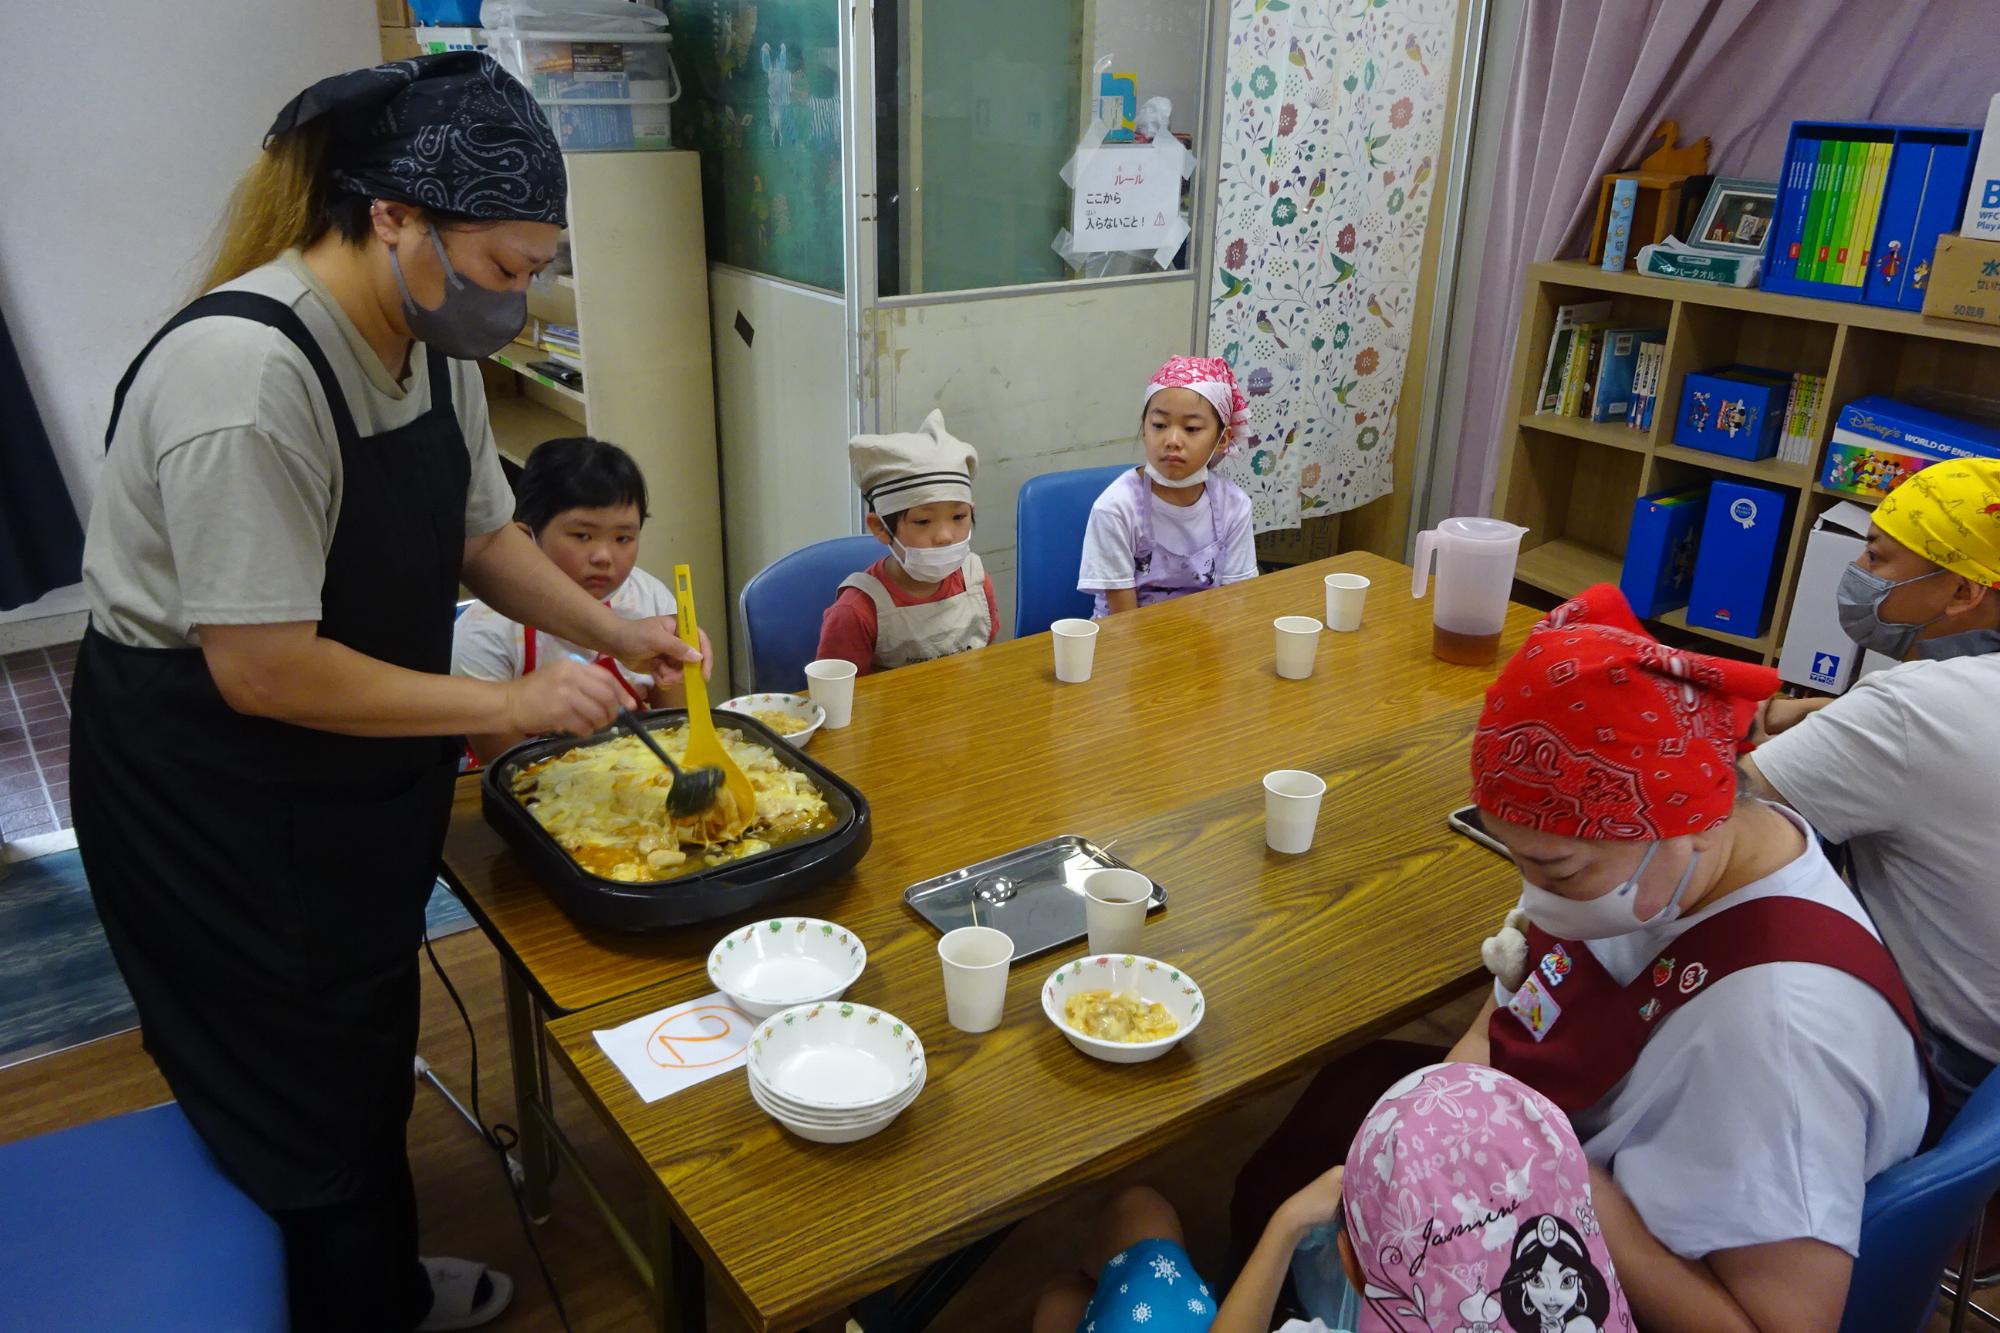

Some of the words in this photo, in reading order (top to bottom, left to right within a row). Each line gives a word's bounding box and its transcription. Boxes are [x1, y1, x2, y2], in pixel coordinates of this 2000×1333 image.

[1114, 175, 1144, 185] ルール
[1086, 192, 1122, 204] ここから
[1904, 433, 1938, 449] WORLD
[1937, 442, 1951, 453] OF
[1408, 1197, 1521, 1277] Jasmine
